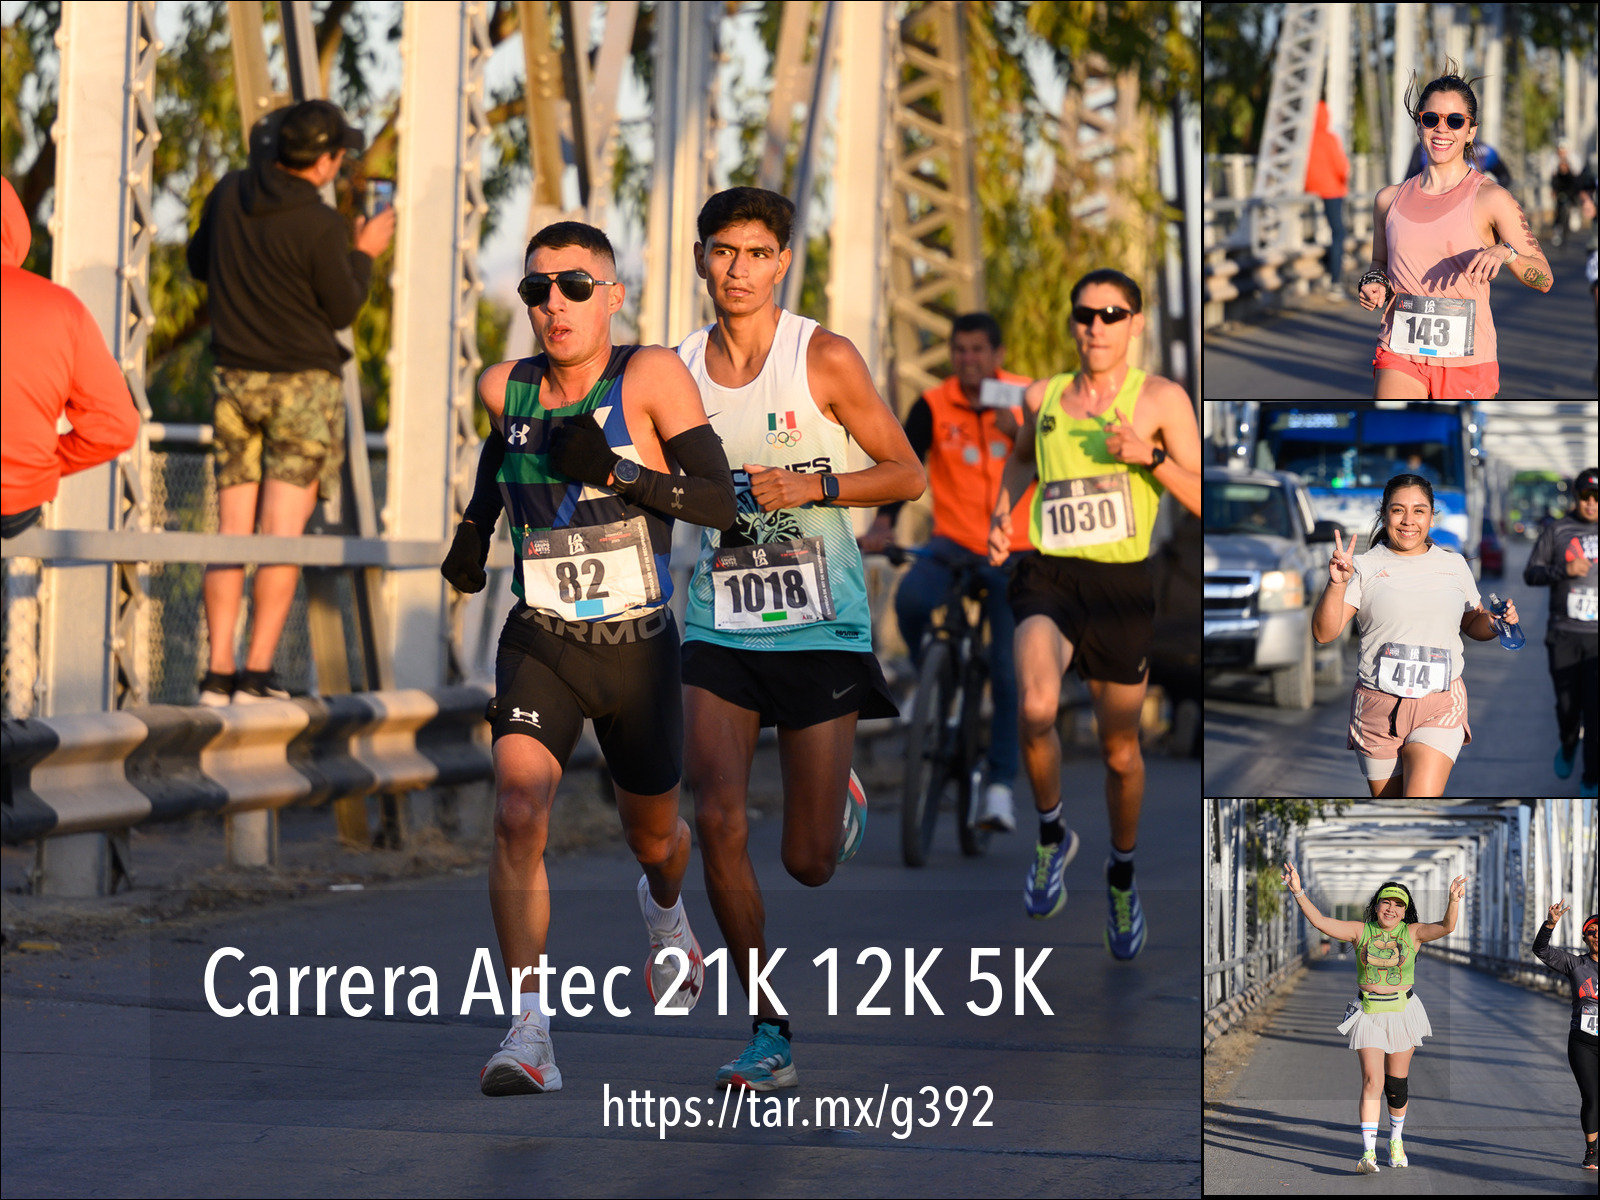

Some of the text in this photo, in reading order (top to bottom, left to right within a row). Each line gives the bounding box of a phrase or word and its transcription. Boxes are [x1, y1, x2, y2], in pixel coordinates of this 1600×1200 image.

[1406, 316, 1451, 347] 143
[1047, 499, 1117, 535] 1030
[556, 558, 610, 604] 82
[724, 569, 808, 614] 1018
[1391, 662, 1431, 689] 414
